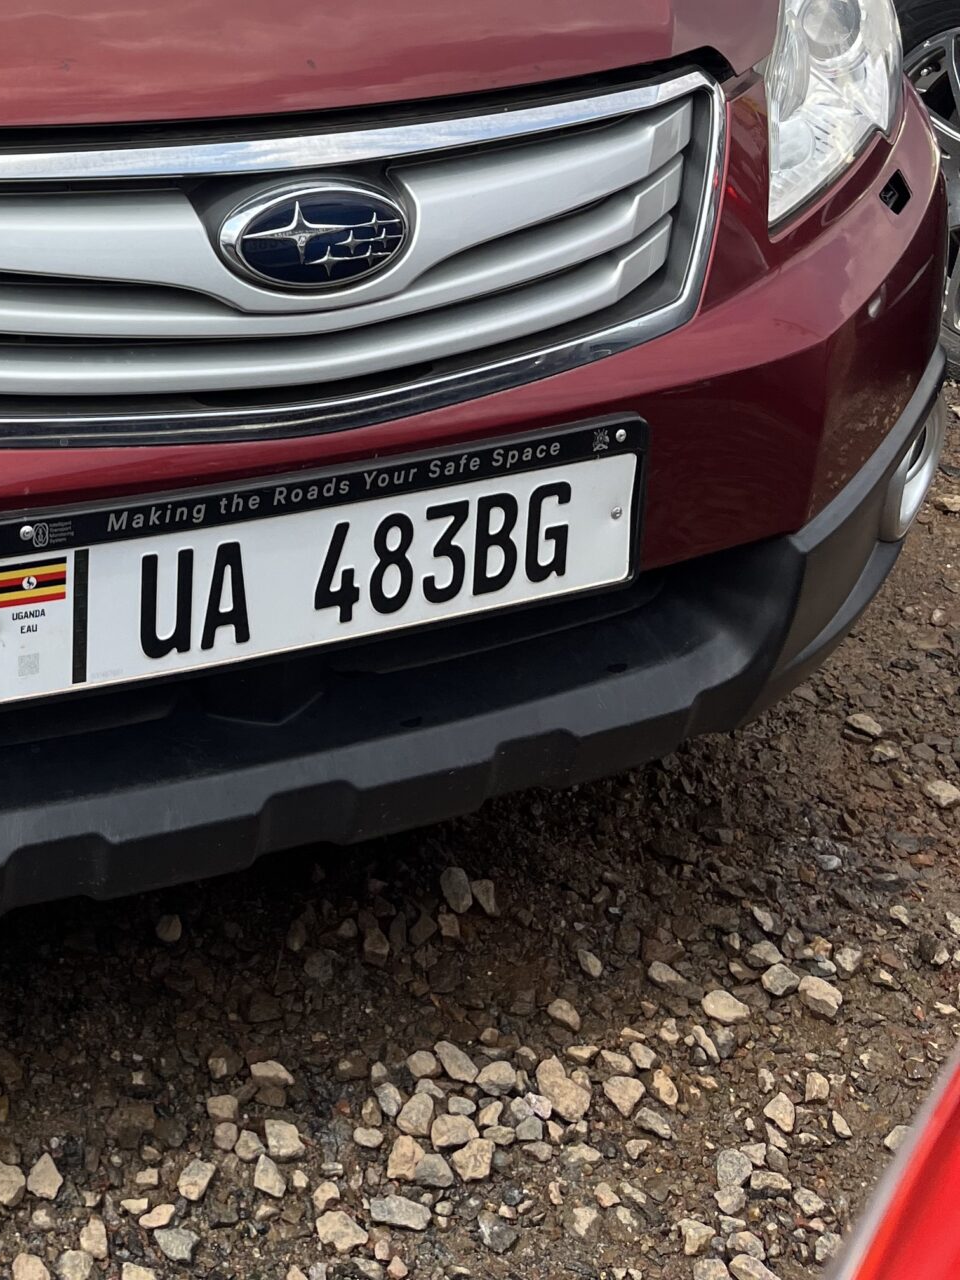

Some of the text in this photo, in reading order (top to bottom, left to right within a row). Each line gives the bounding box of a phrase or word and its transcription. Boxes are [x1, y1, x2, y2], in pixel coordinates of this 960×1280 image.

[107, 441, 561, 532] Making the Roads Your Safe Space
[138, 481, 573, 660] UA 483BG
[11, 608, 46, 621] UGANDA
[20, 624, 38, 634] EAU
